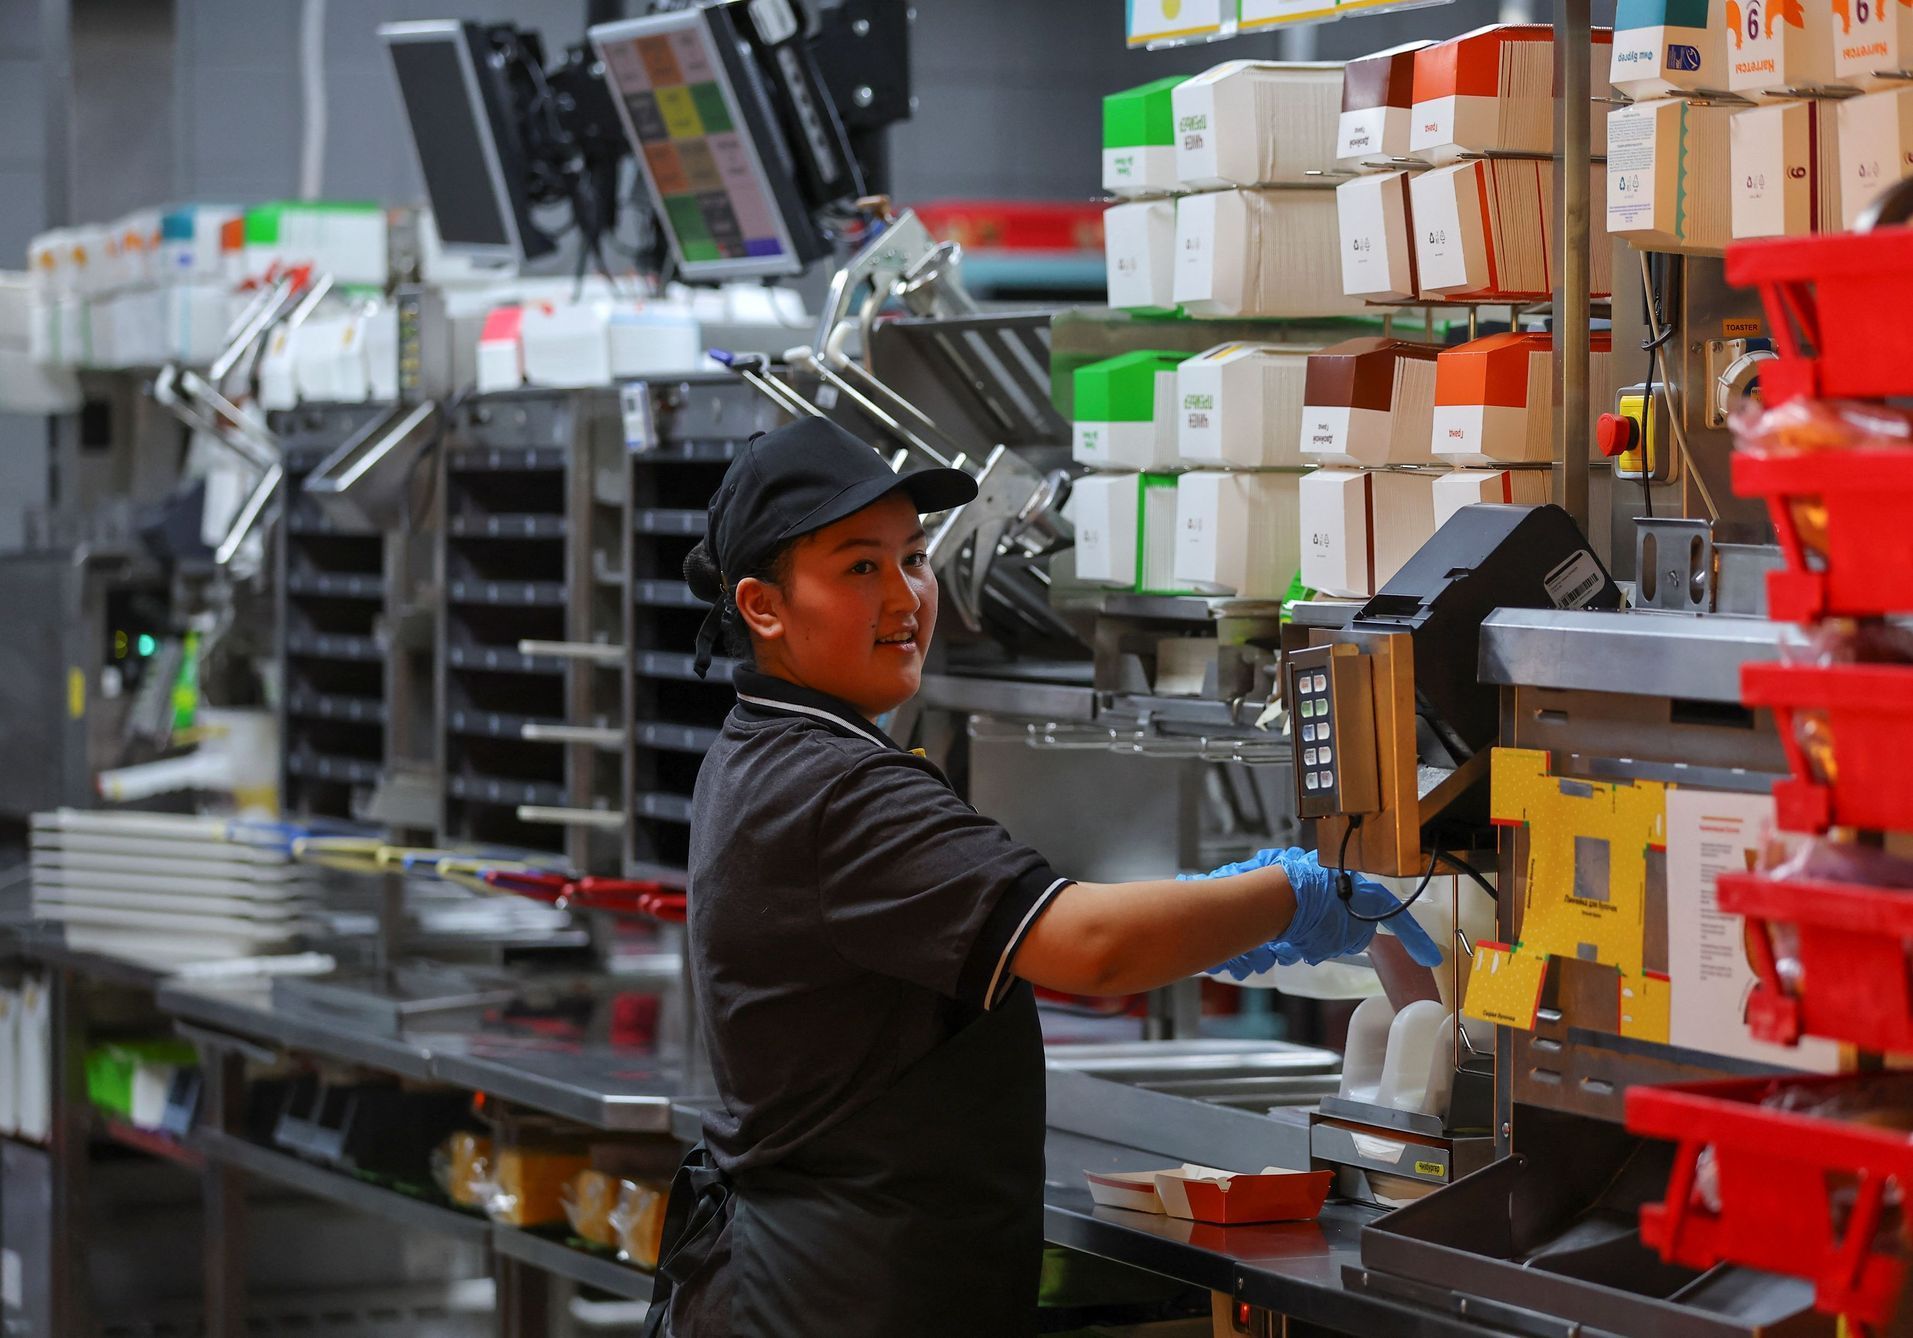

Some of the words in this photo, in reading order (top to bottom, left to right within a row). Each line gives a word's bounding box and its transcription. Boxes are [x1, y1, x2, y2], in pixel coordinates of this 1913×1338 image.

[1843, 42, 1888, 60] Наггетсы
[1735, 59, 1775, 74] Наггетсы
[1726, 323, 1758, 331] TOASTER
